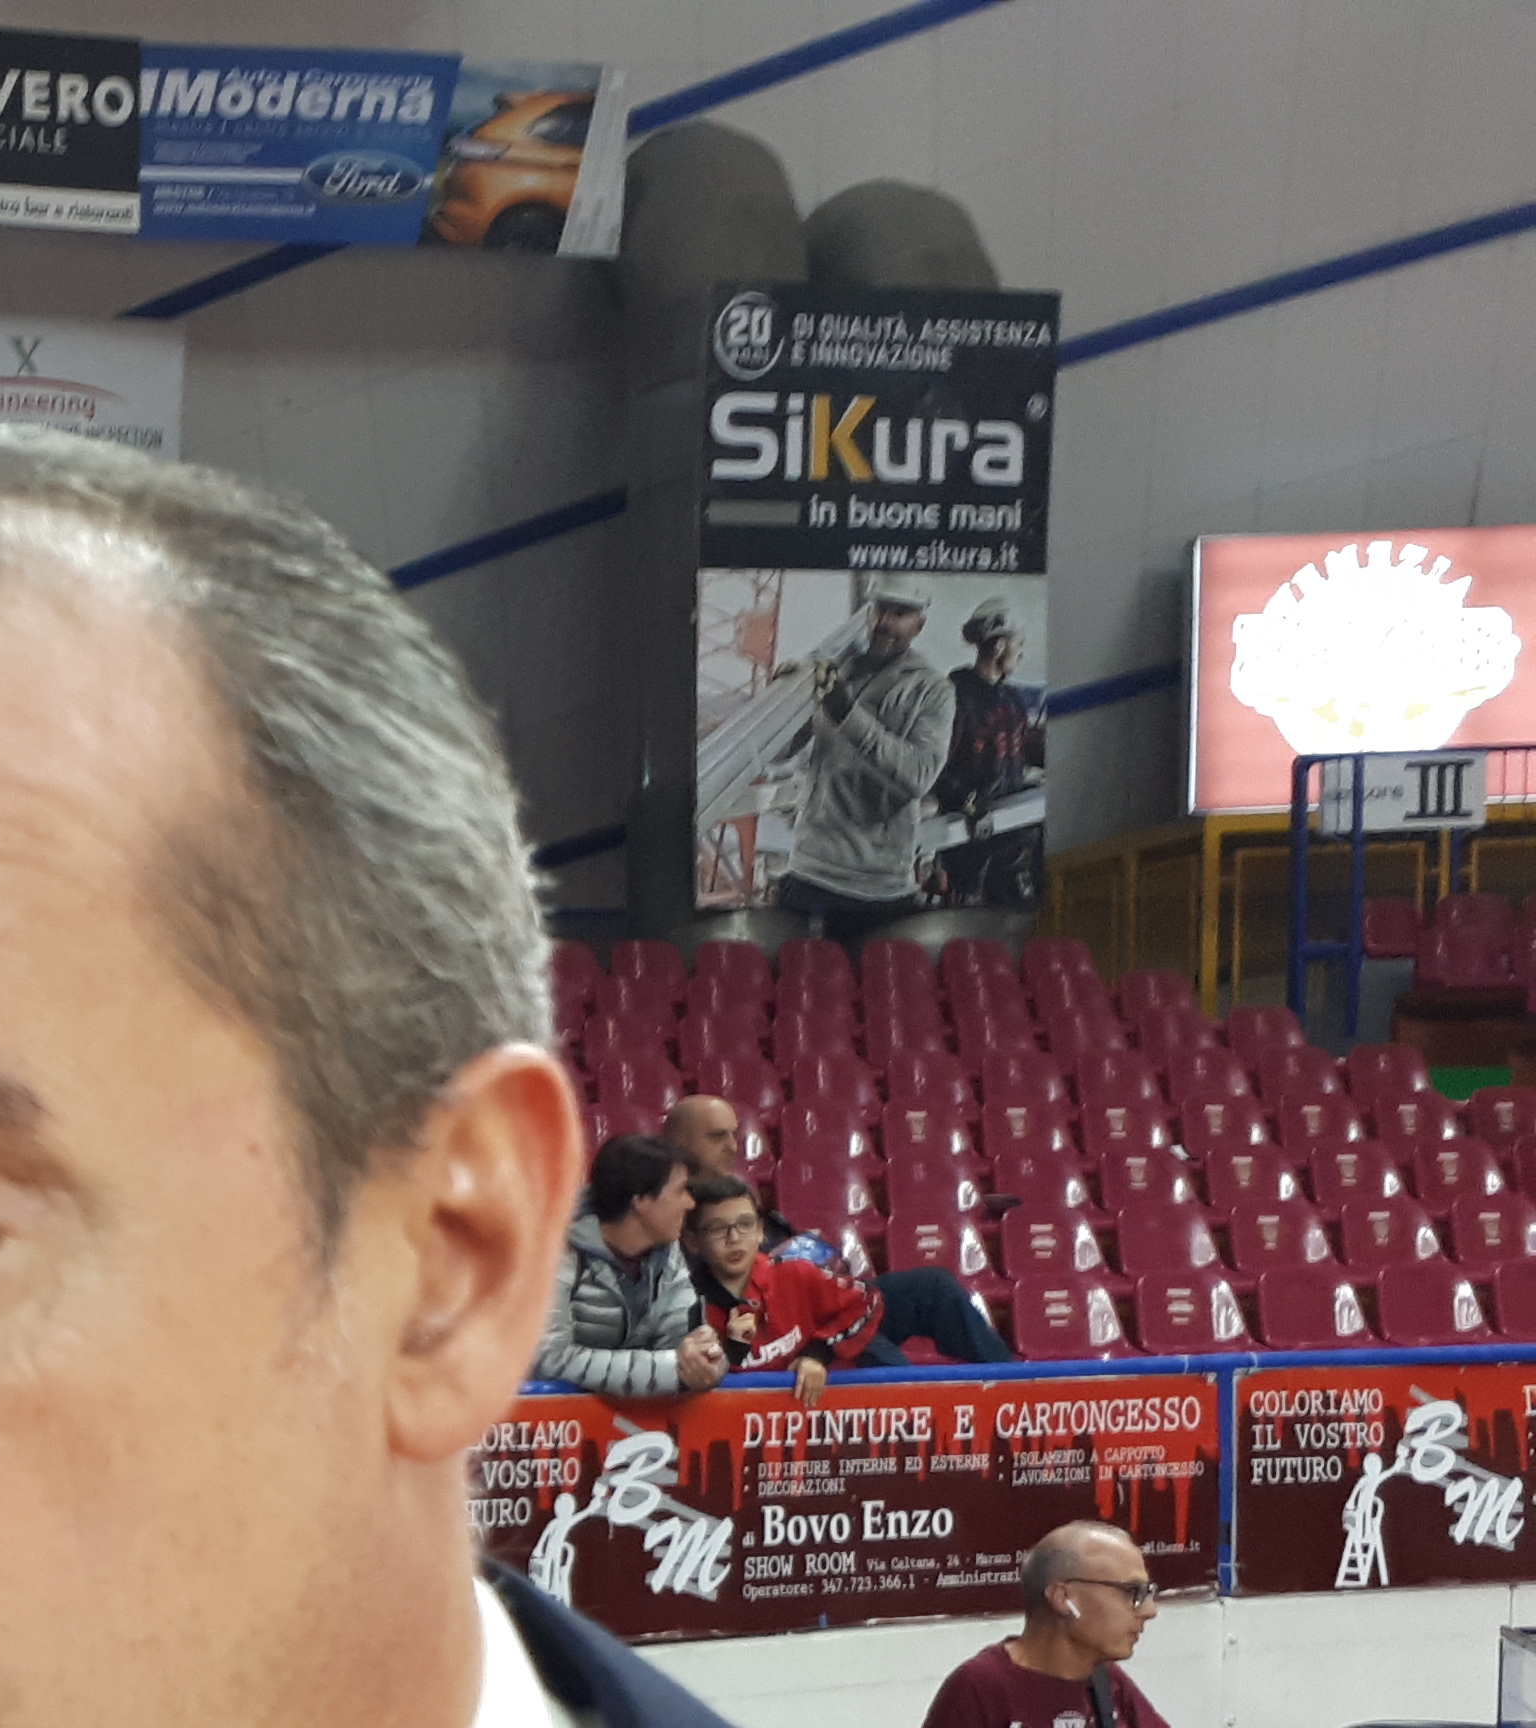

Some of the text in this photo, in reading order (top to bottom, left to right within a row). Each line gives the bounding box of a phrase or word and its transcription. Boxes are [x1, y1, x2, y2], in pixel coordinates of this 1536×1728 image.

[323, 159, 401, 198] Ford
[729, 304, 773, 347] 20
[921, 317, 1052, 348] ASSISTENZA
[791, 340, 954, 373] E INNOVAZIONE
[809, 494, 1023, 532] in buone mani
[848, 543, 1019, 571] www.sikura.it
[1403, 757, 1475, 822] III
[1249, 1388, 1384, 1418] COLORIAMO
[743, 1396, 1201, 1449] DIPINTURE E CARTONGESSO
[1251, 1421, 1385, 1451] IL VOSTRO
[757, 1452, 990, 1480] DIPINTURE INTERNE ED ESTERNE
[1012, 1445, 1166, 1468] ISOLAMENTO A CAPPOTTO
[1250, 1455, 1343, 1485] FUTURO
[481, 1457, 581, 1490] VOSTRO
[758, 1477, 847, 1497] DECORAZIONI
[1011, 1460, 1205, 1487] LAVORAZIONI IN CARTONGESSO
[466, 1496, 531, 1527] TURO
[742, 1499, 954, 1548] di Bovo Enzo
[743, 1555, 794, 1580] SHOW
[805, 1551, 857, 1576] ROOM
[866, 1557, 886, 1572] Via
[742, 1582, 815, 1602] Operatore:
